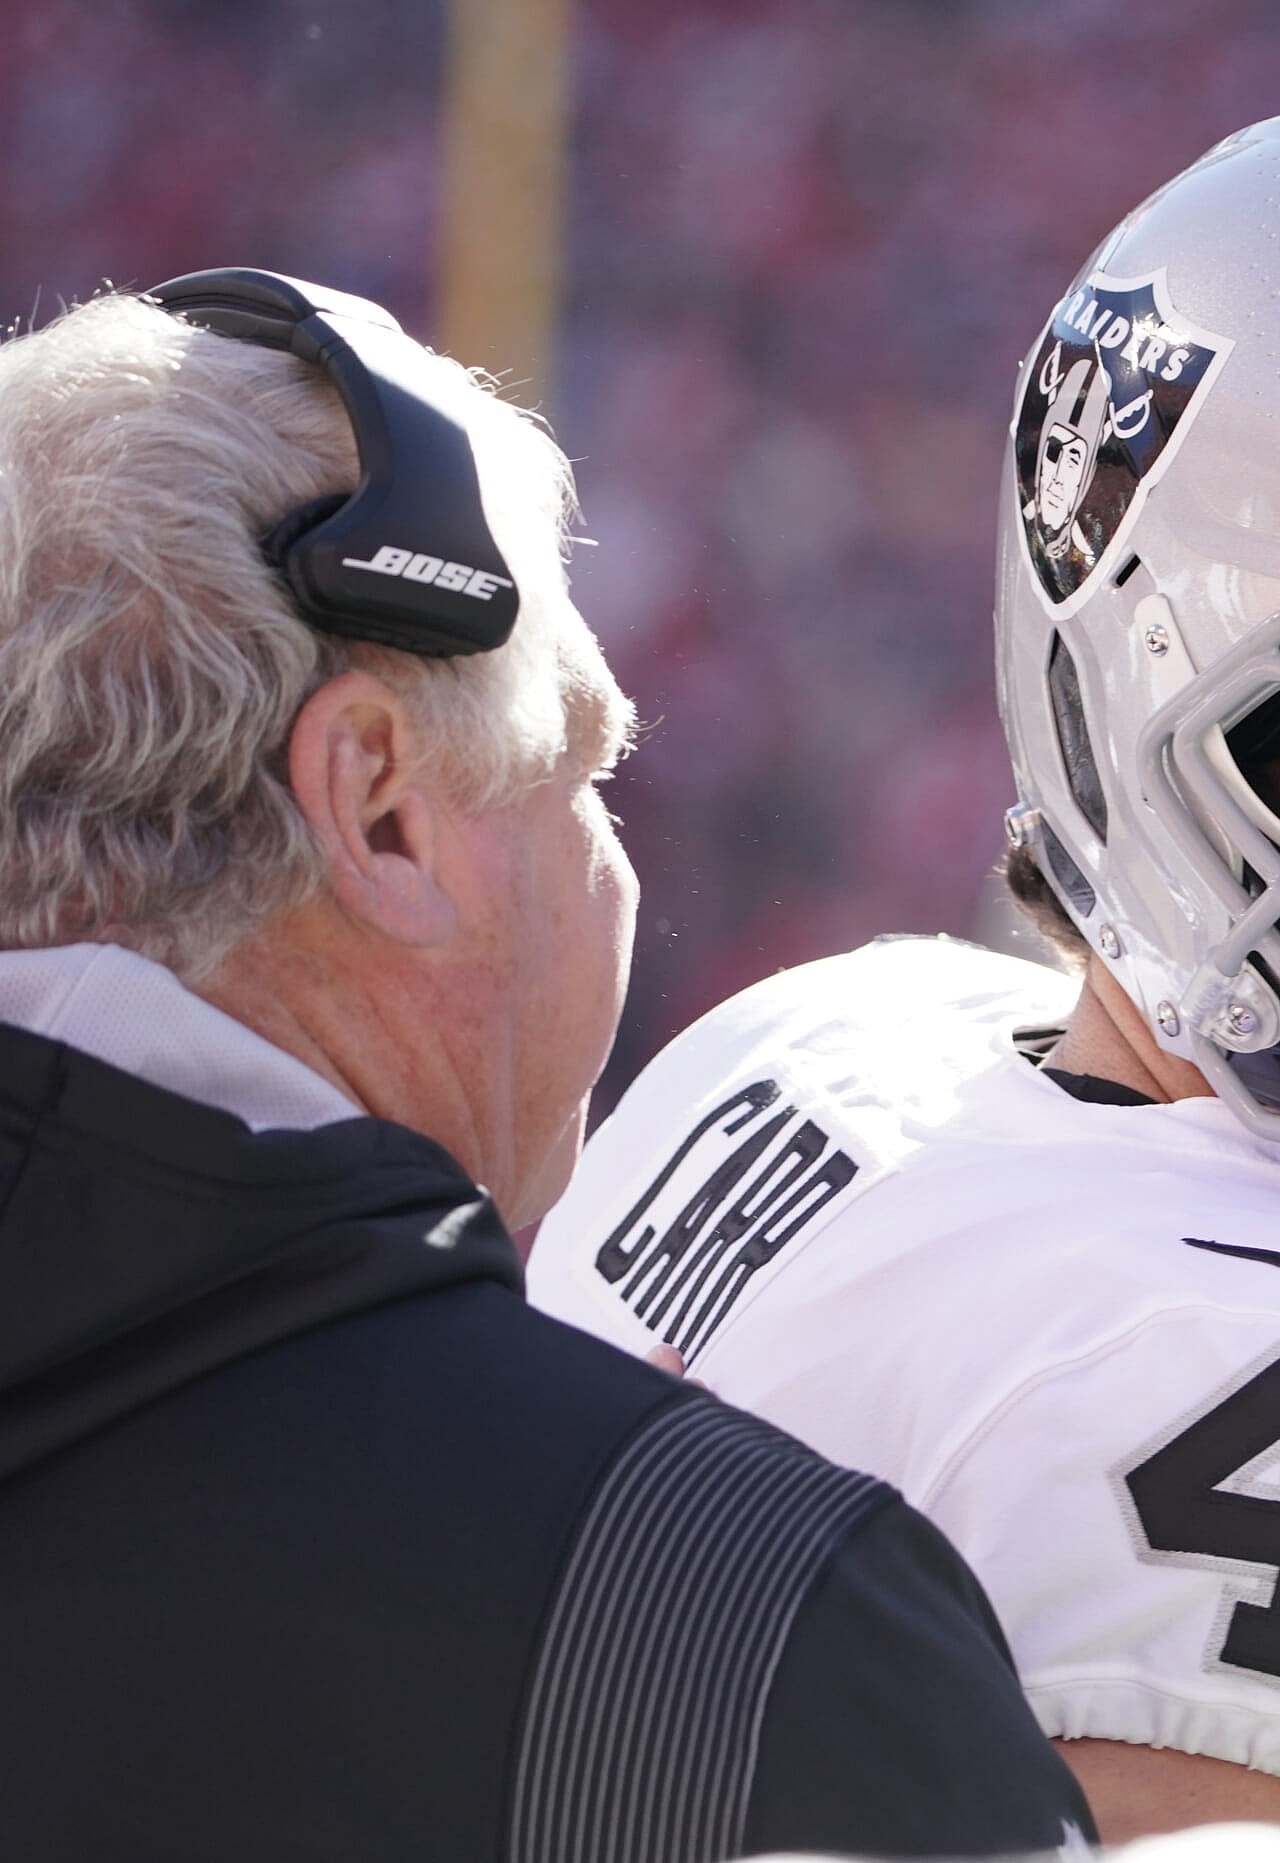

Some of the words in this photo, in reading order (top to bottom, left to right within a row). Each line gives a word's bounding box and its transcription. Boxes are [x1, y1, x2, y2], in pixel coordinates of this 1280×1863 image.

[1063, 291, 1190, 382] RAIDERS
[342, 545, 513, 601] BOSE
[595, 1078, 860, 1370] CARR
